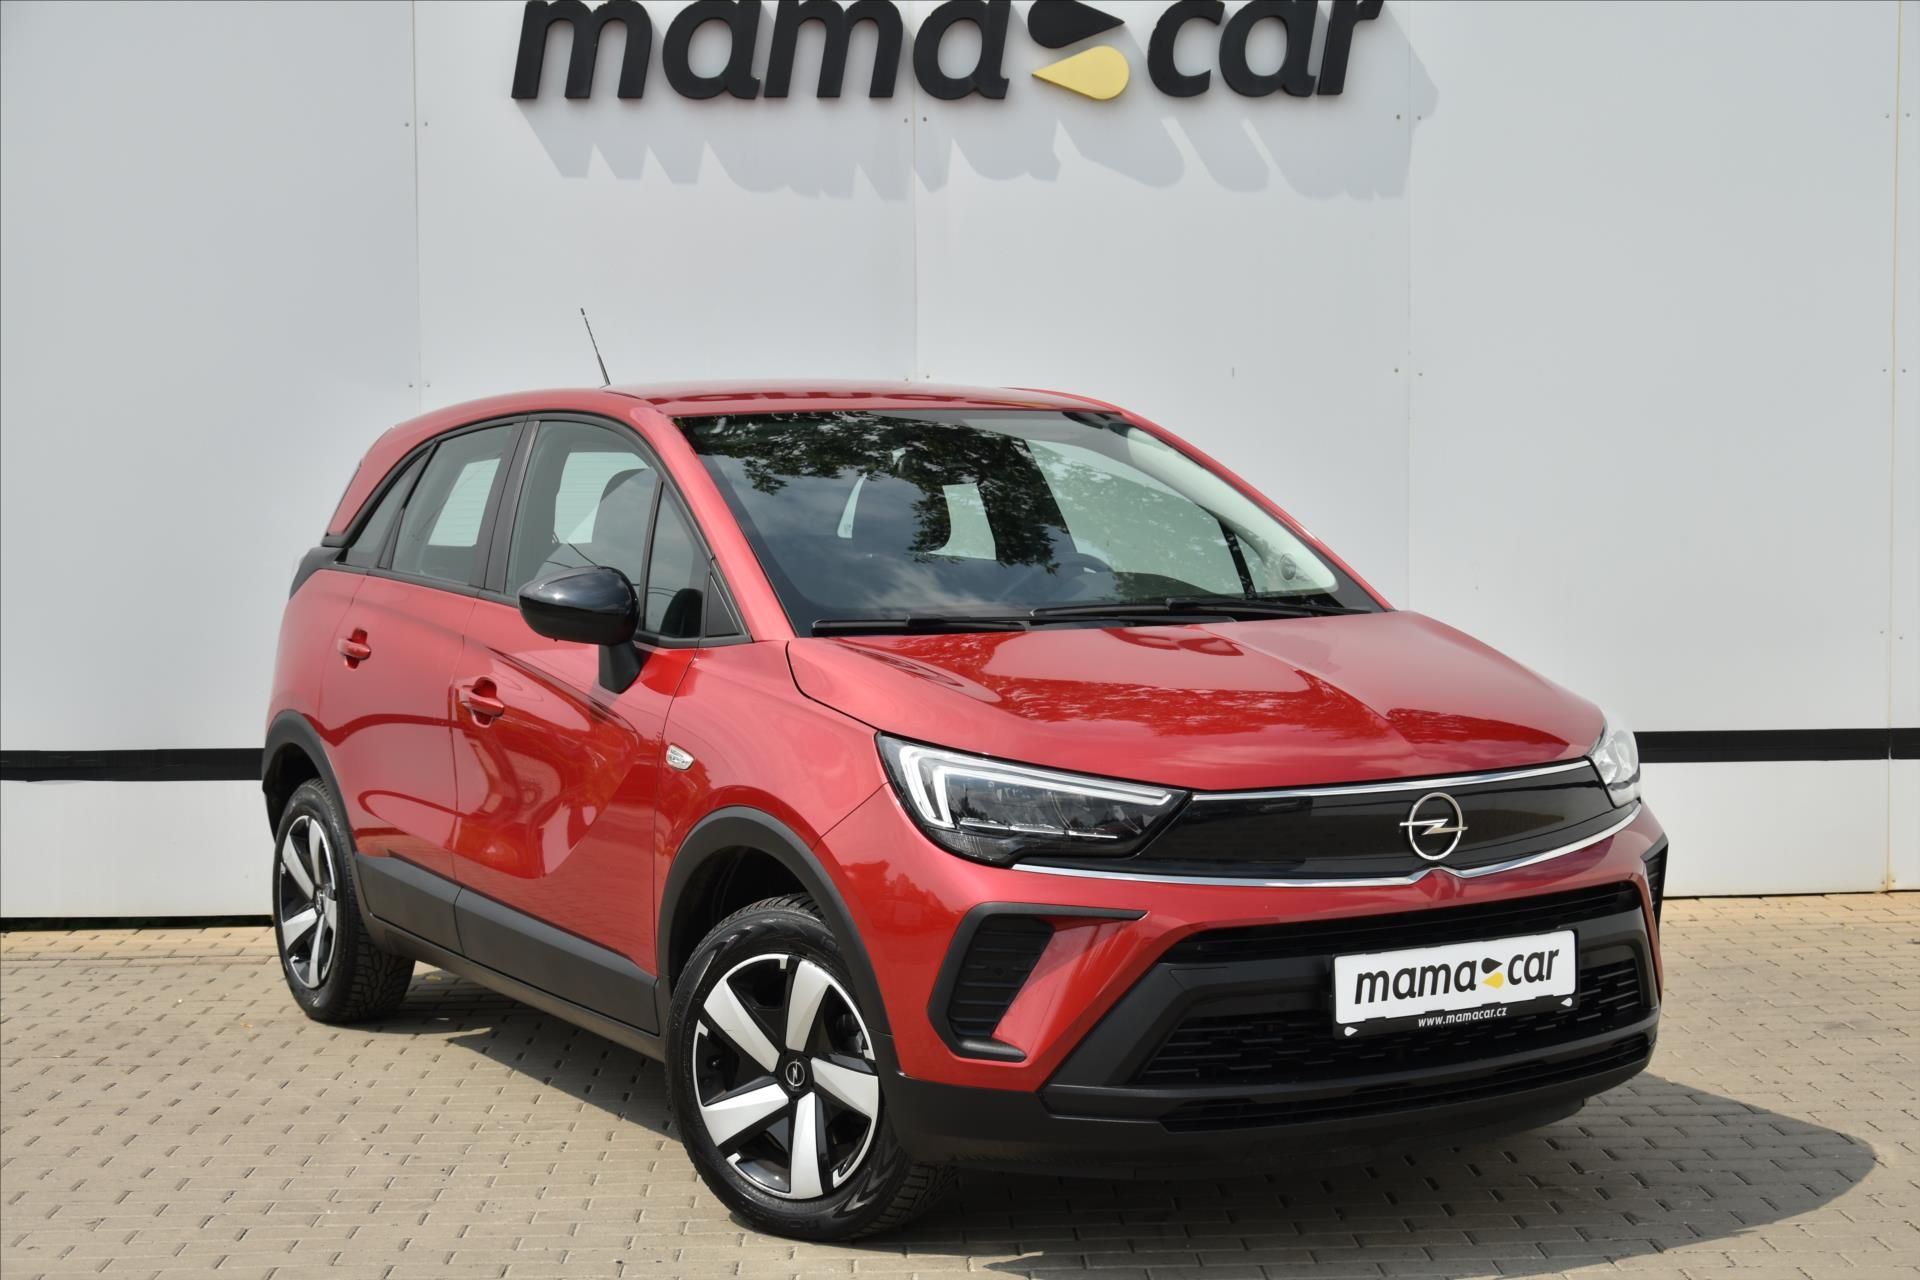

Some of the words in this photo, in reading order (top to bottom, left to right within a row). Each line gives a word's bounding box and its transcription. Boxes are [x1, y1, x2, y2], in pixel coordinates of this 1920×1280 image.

[511, 0, 1010, 99] mama
[1147, 0, 1385, 98] car
[1354, 959, 1477, 1004] mama
[1507, 949, 1560, 985] car
[1418, 1007, 1507, 1027] www.mamacar.cz
